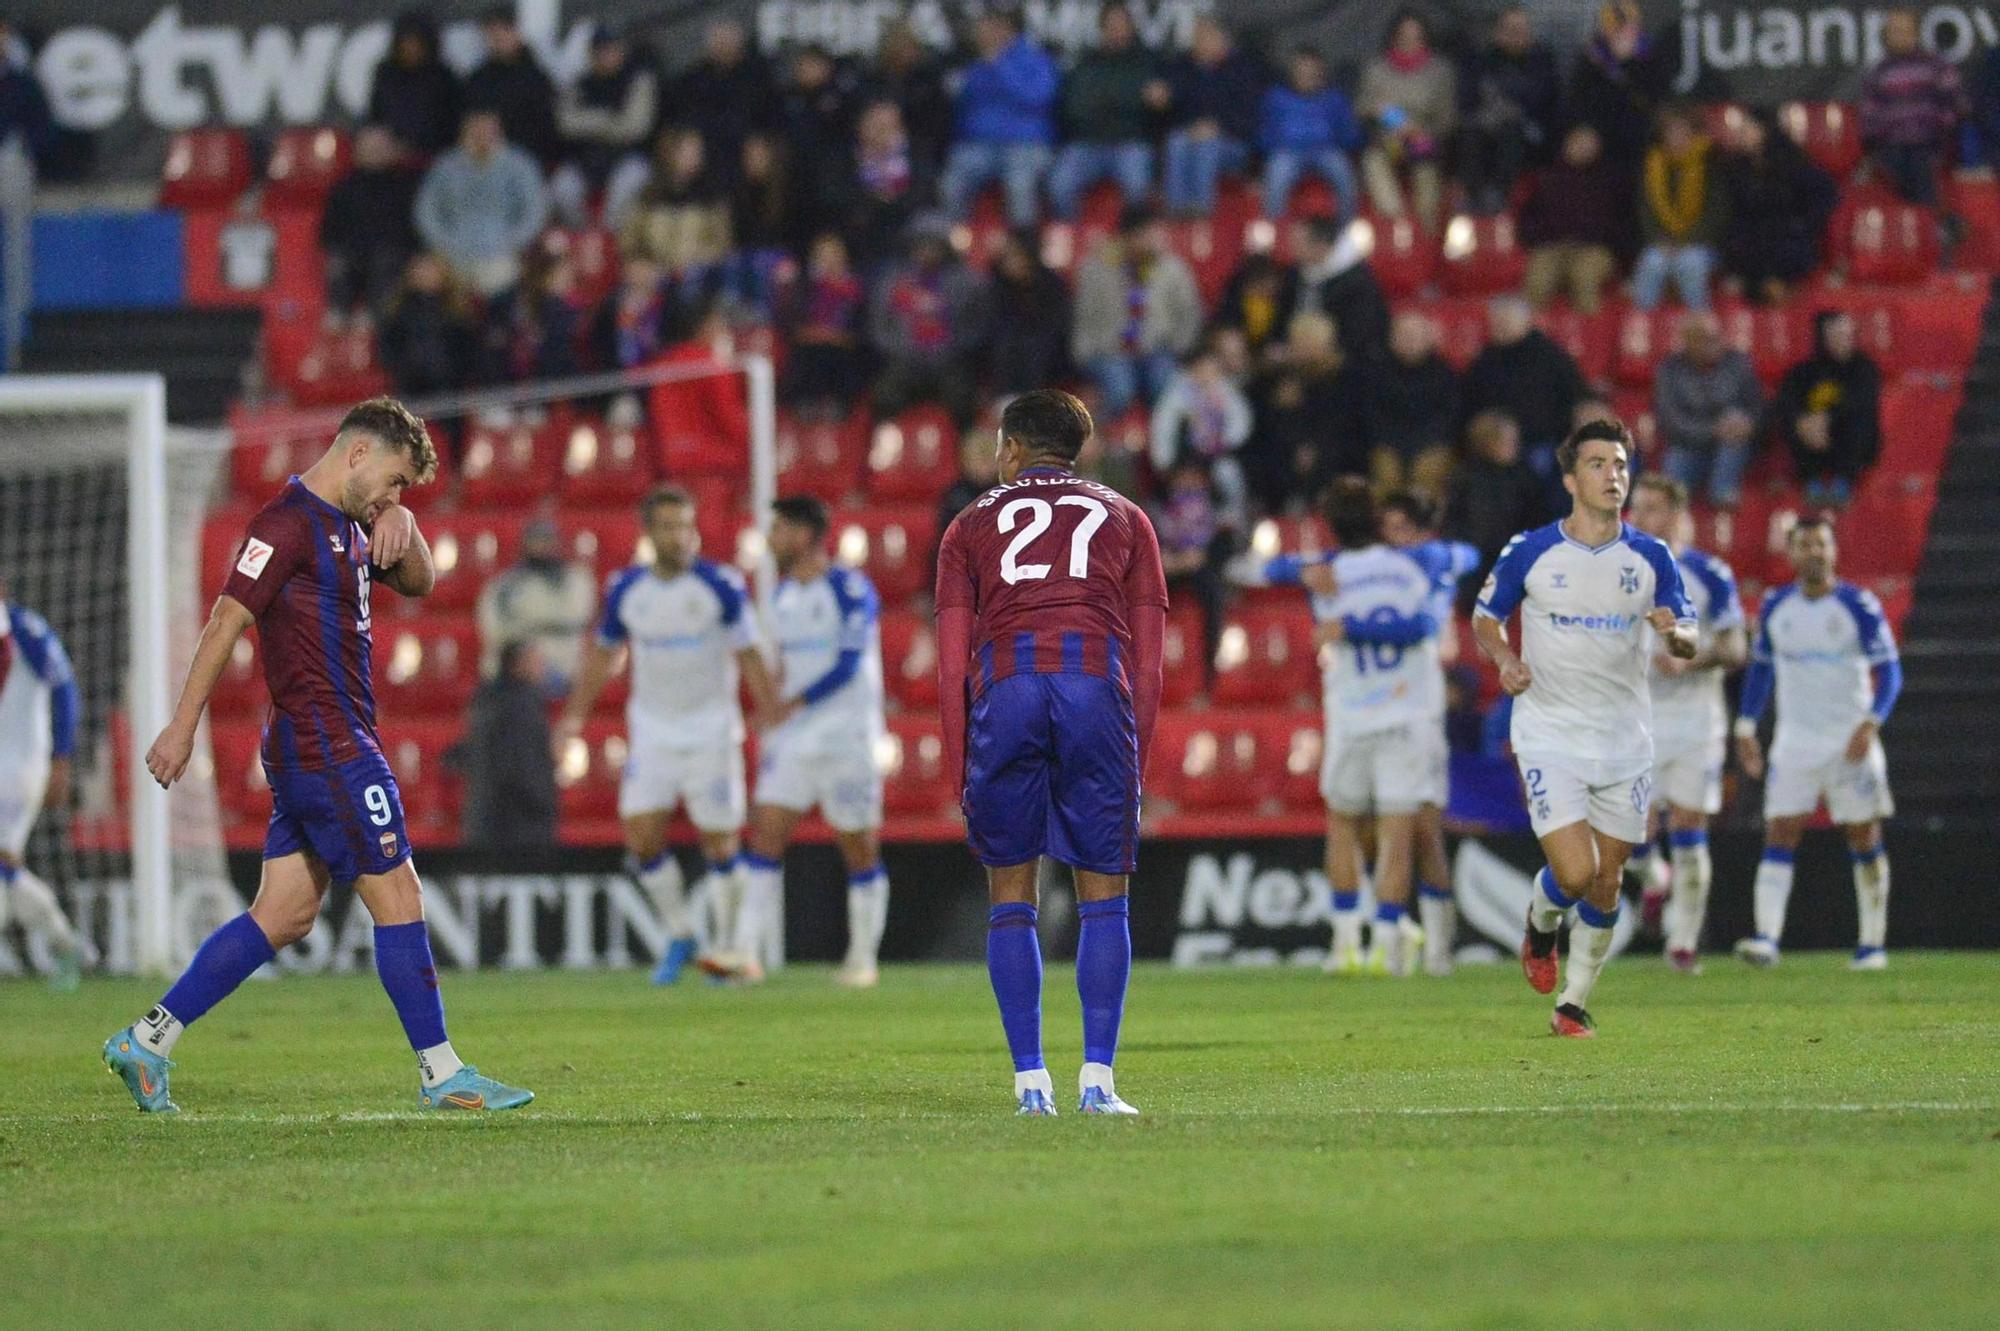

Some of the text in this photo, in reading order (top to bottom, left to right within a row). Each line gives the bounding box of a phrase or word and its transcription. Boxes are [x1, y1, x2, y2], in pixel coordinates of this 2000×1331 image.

[997, 495, 1109, 586] 27
[1526, 768, 1547, 796] 2
[364, 784, 392, 826] 9
